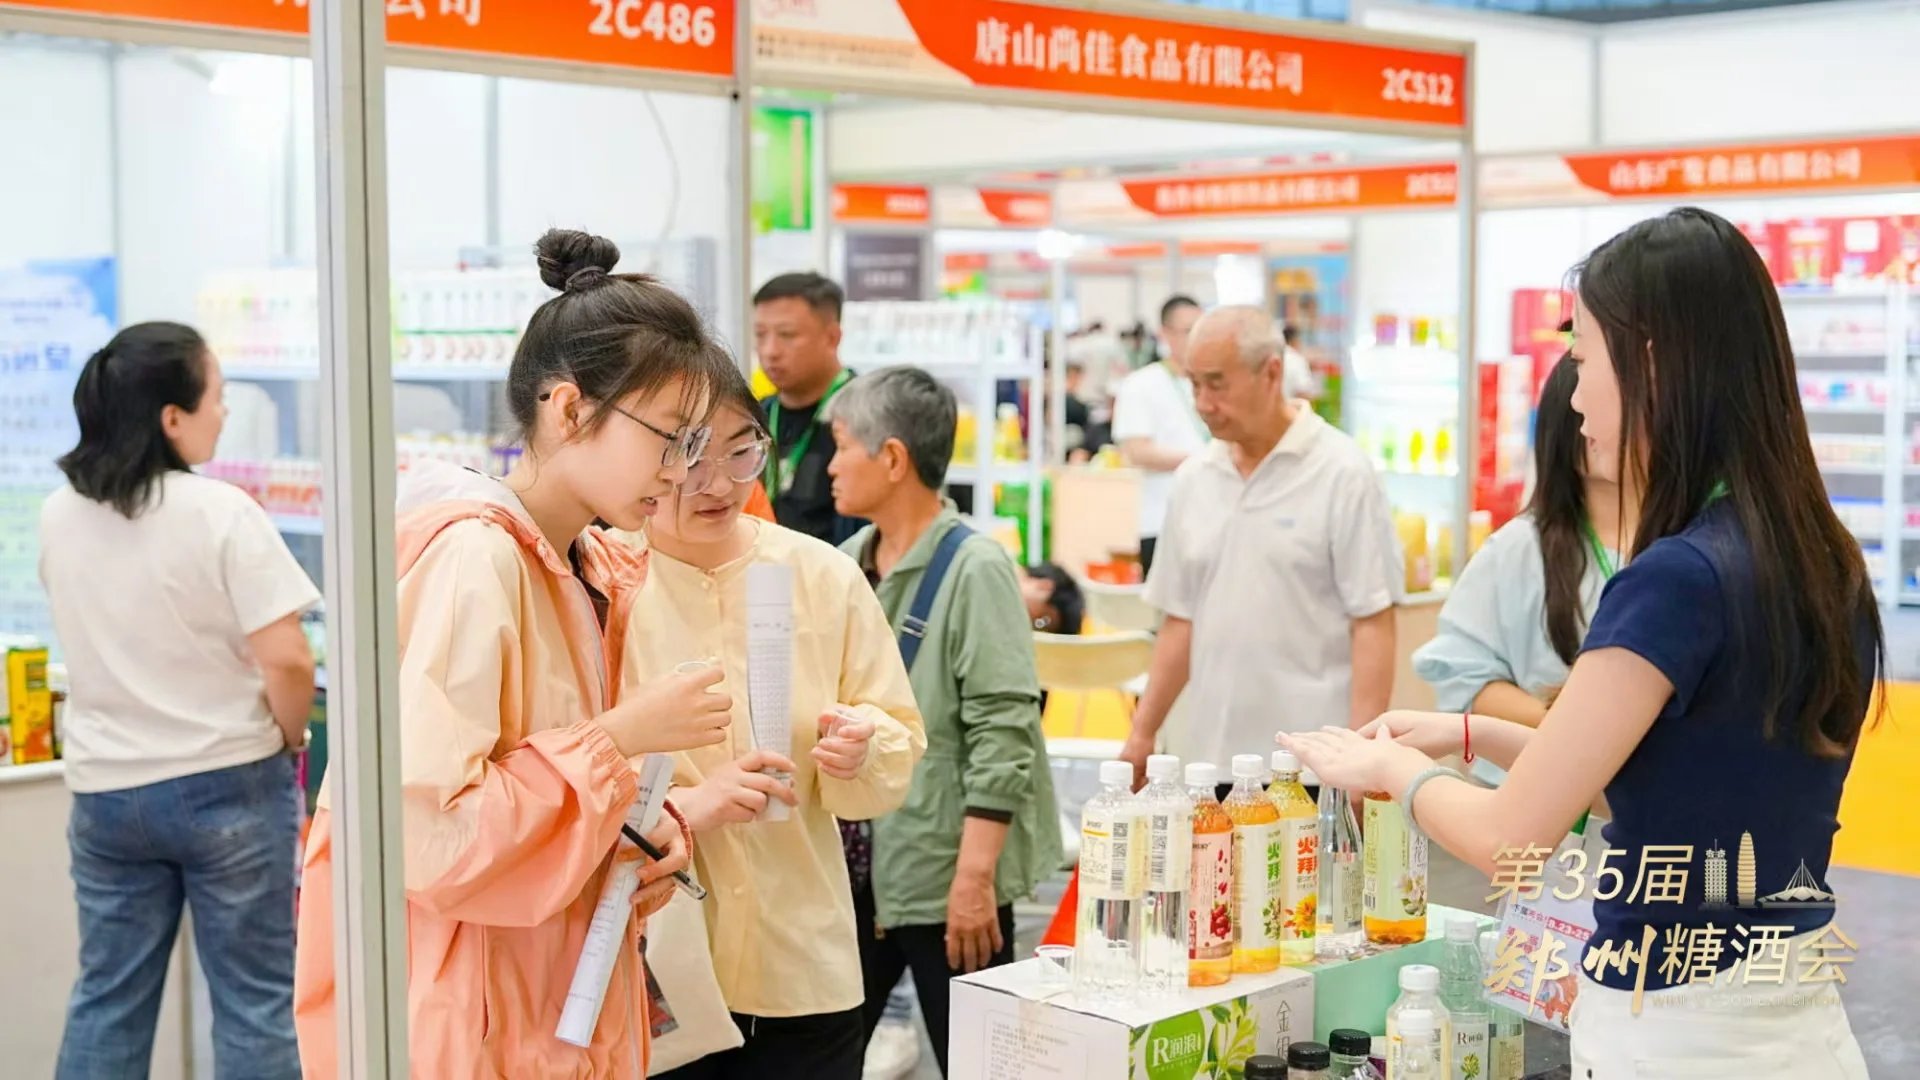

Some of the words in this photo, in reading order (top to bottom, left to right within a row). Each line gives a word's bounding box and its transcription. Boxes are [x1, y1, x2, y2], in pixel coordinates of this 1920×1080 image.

[588, 0, 716, 46] 2C486
[973, 16, 1305, 96] 唐山尚佳食品有限公司
[1381, 68, 1454, 107] 2C512
